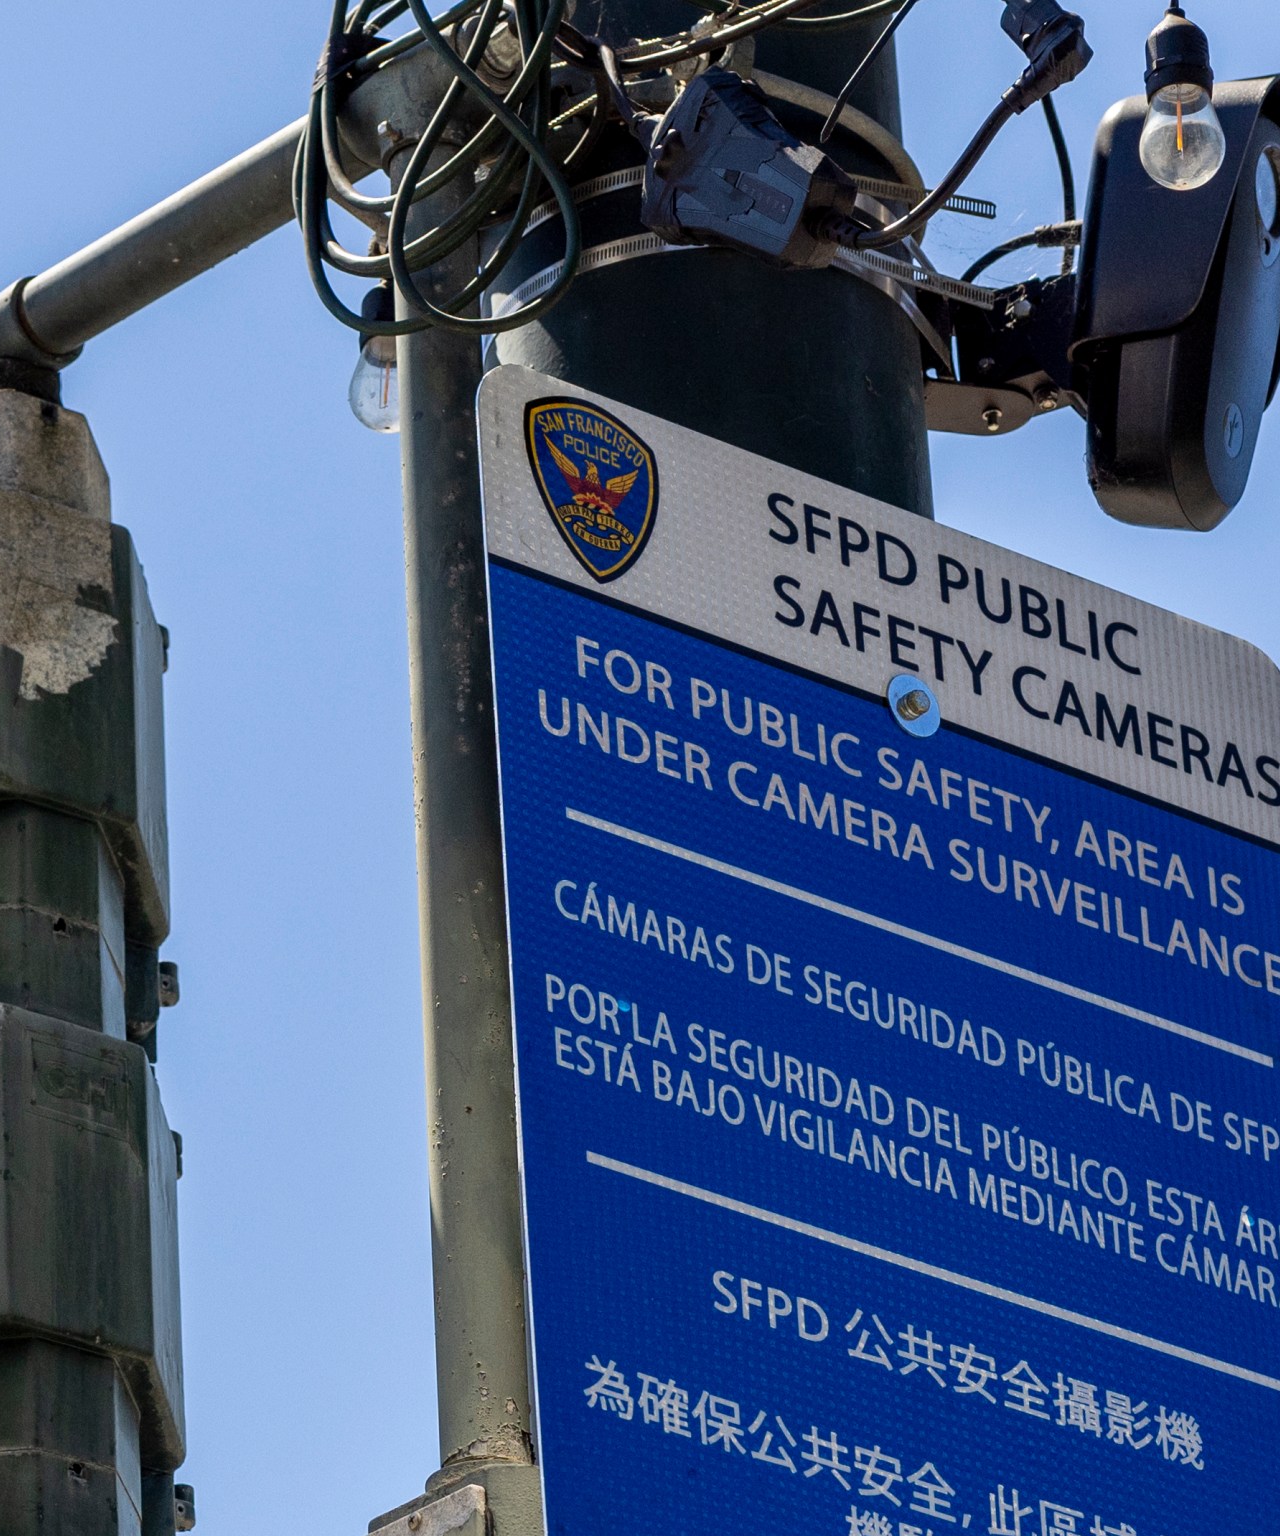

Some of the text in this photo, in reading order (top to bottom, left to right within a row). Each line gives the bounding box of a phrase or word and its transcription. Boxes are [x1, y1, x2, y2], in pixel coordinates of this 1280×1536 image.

[536, 411, 646, 468] SAN FRANCISCO
[563, 433, 622, 469] POLICE
[767, 492, 1142, 676] SFPD PUBLIC
[773, 575, 993, 696] SAFETY
[538, 689, 713, 790] UNDER
[728, 761, 934, 870] CAMERA
[576, 636, 1245, 915] FOR PUBLIC SAFETY, AREA IS
[554, 879, 735, 974] CÁMARAS
[746, 944, 794, 996] DE
[803, 965, 1006, 1067] SEGURIDAD
[1017, 1039, 1161, 1123] PÚBLICA
[1170, 1092, 1215, 1142] DE
[545, 973, 621, 1035] POR
[631, 1003, 677, 1054] LA
[687, 1023, 895, 1126] SEGURIDAD
[906, 1097, 973, 1155] DEL
[982, 1123, 1137, 1216] PÚBLICO,
[1146, 1179, 1225, 1242] ESTA
[554, 1027, 641, 1093] ESTÁ
[652, 1059, 745, 1126] BAJO
[753, 1093, 958, 1199] VIGILANCIA
[968, 1167, 1147, 1263] MEDIANTE
[712, 1270, 1204, 1471] SFPD 公共安全攝影機
